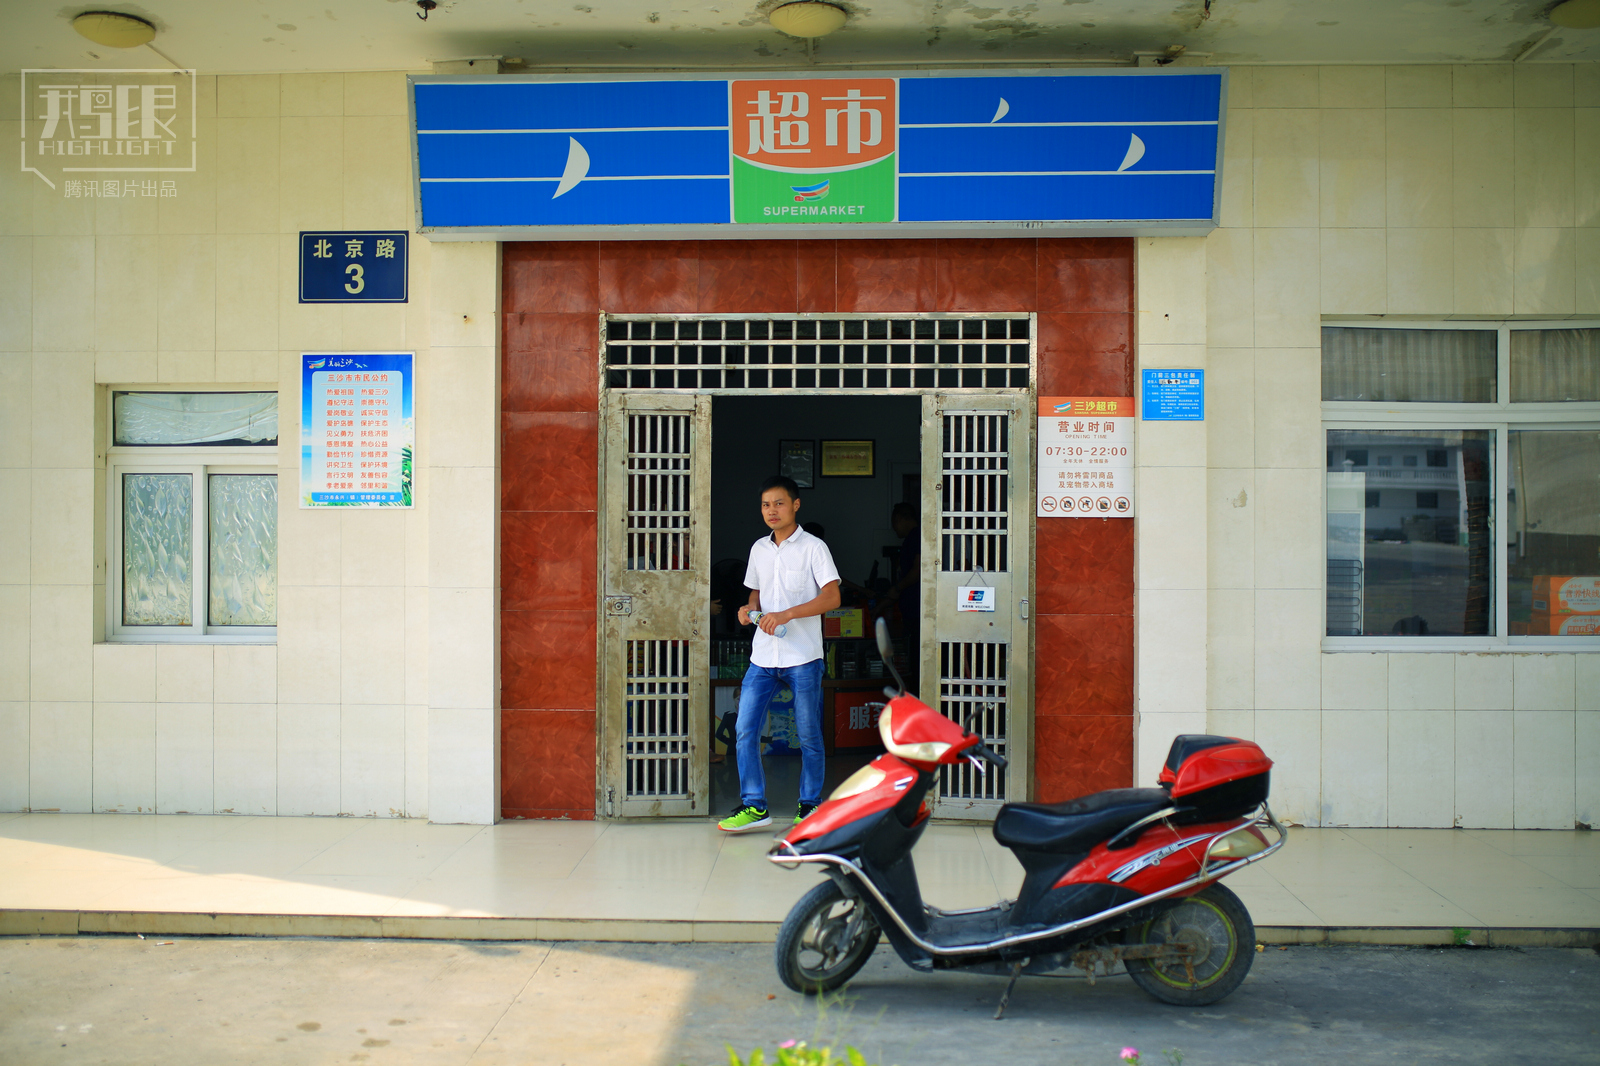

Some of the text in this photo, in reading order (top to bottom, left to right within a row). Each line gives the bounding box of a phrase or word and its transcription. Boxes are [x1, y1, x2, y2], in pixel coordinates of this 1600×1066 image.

[746, 89, 887, 155] 超市
[763, 205, 866, 216] SUPERMARKET
[313, 239, 396, 258] 北京路
[344, 263, 365, 294] 3
[327, 374, 388, 382] 三沙市市民公约
[1074, 401, 1118, 412] 三沙超市
[1058, 421, 1116, 433] 营业时间
[1046, 446, 1127, 456] 07:30-22:00
